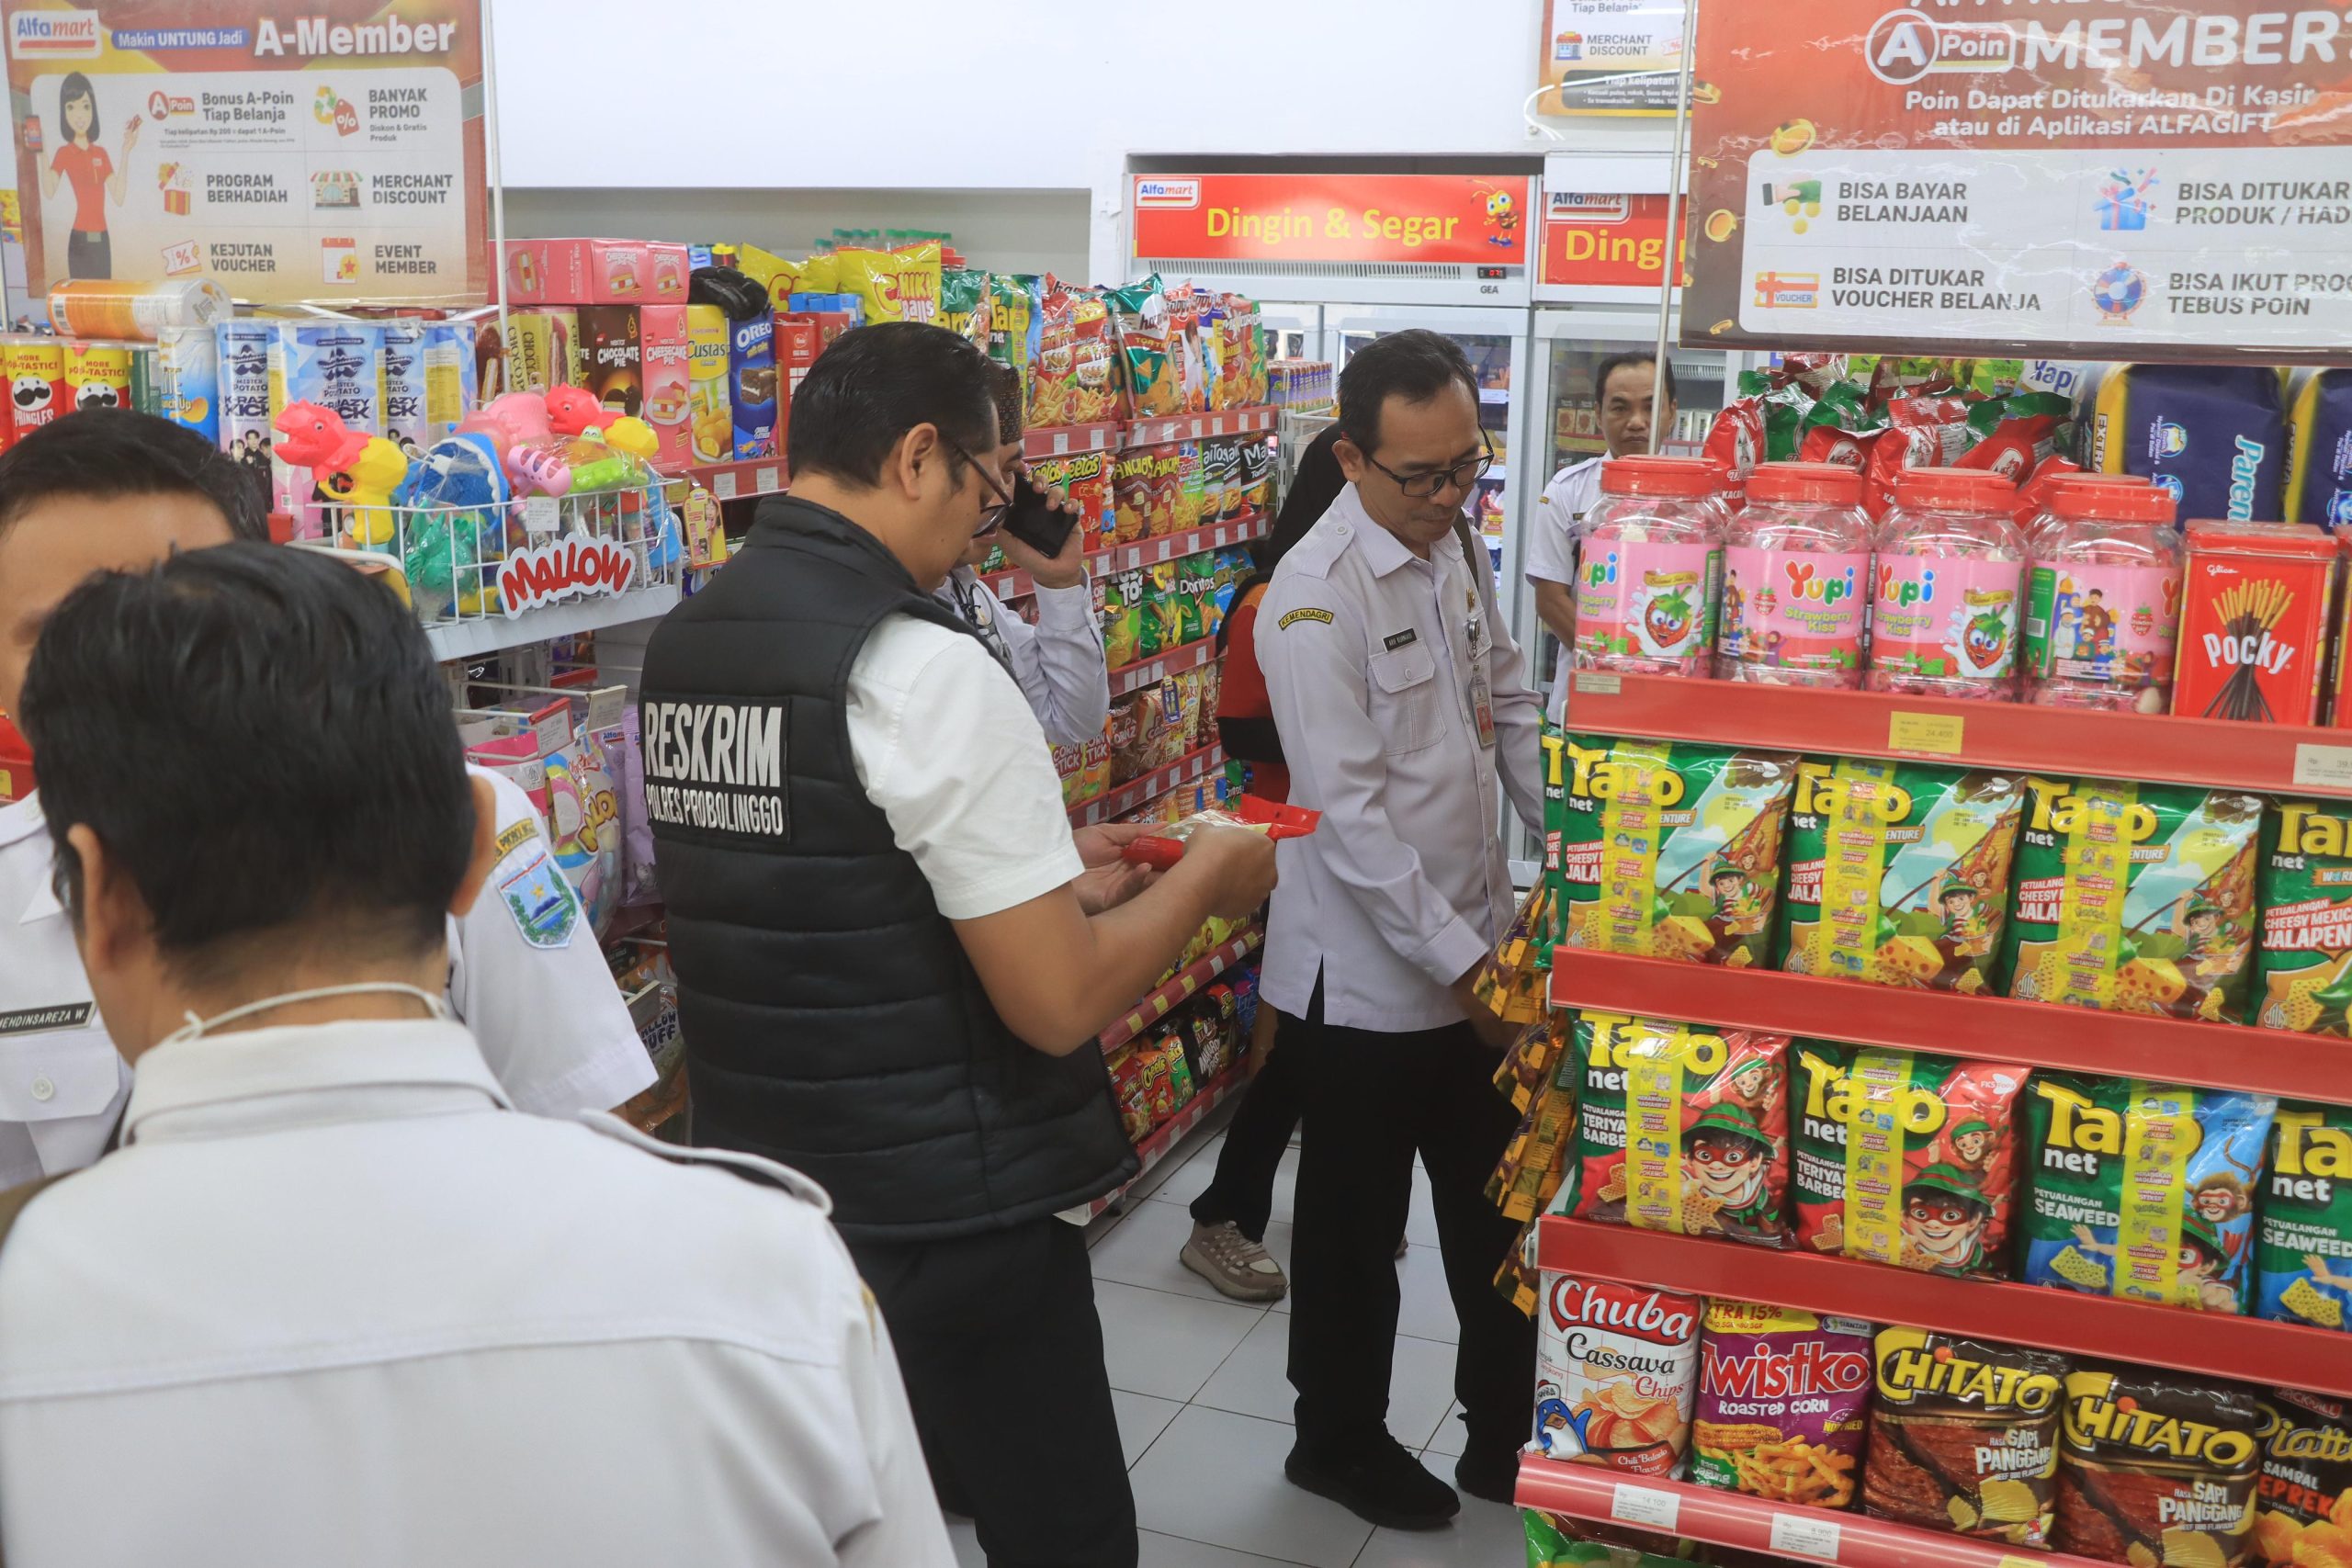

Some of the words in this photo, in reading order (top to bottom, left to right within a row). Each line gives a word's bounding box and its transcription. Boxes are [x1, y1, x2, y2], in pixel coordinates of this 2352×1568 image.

[1572, 3, 1595, 15] Tiap
[17, 16, 94, 38] Alfamart
[119, 33, 154, 48] Makin
[158, 31, 216, 47] UNTUNG
[219, 30, 243, 46] Jadi
[254, 16, 456, 57] A-Member
[1587, 35, 1653, 44] MERCHANT
[1877, 21, 1927, 67] A
[1940, 29, 2006, 58] Poin
[1589, 46, 1648, 56] DISCOUNT
[1628, 75, 1675, 86] kelipatan
[202, 93, 243, 105] Bonus
[246, 92, 294, 105] A-Poin
[368, 88, 427, 103] BANYAK
[1905, 90, 1959, 111] Poin
[1967, 90, 2044, 113] Dapat
[2051, 88, 2197, 110] Ditukarkan
[2205, 86, 2234, 107] Di
[2244, 82, 2314, 107] Kasir
[171, 100, 193, 110] Poin
[369, 105, 420, 118] PROMO
[203, 107, 230, 122] Tiap
[233, 107, 286, 122] Belanja
[1934, 118, 1990, 137] atau
[1996, 116, 2019, 136] di
[2027, 114, 2132, 139] Aplikasi
[2138, 111, 2277, 134] ALFAGIFT
[207, 175, 274, 188] PROGRAM
[372, 175, 453, 188] MERCHANT
[1141, 183, 1193, 197] Alfamart
[208, 189, 288, 204] BERHADIAH
[373, 190, 447, 204] DISCOUNT
[1553, 192, 1622, 208] Alfamart
[1838, 182, 1888, 199] BISA
[1895, 183, 1967, 200] BAYAR
[2178, 183, 2233, 200] BISA
[2242, 182, 2350, 200] DITUKAR
[1838, 205, 1968, 222] BELANJAAN
[2176, 207, 2277, 224] PRODUK
[2298, 206, 2352, 224] HAD
[1207, 208, 1313, 244] Dingin
[1325, 209, 1351, 239] &
[1363, 209, 1459, 246] Segar
[209, 243, 273, 258] KEJUTAN
[375, 245, 422, 258] EVENT
[1566, 228, 1665, 270] Ding
[211, 258, 276, 273] VOUCHER
[376, 261, 436, 274] MEMBER
[1833, 267, 1883, 285] BISA
[1889, 269, 1984, 287] DITUKAR
[2169, 273, 2223, 290] BISA
[2232, 274, 2288, 291] IKUT
[1480, 285, 1498, 294] GEA
[1775, 294, 1812, 302] VOUCHER
[1833, 290, 1934, 309] VOUCHER
[1940, 292, 2041, 311] BELANJA
[2168, 296, 2244, 315] TEBUS
[2251, 297, 2311, 315] POIN
[736, 322, 772, 349] OREO
[598, 346, 640, 364] CHOCOLATE
[614, 358, 627, 367] PIE
[646, 345, 688, 362] CHEESECAKE
[663, 355, 675, 366] PIE
[15, 409, 54, 427] PRINGLES
[2094, 413, 2108, 473] EXTRA
[2227, 434, 2264, 520] Paren
[502, 542, 632, 611] MALLOW
[2207, 565, 2239, 576] Glico
[1180, 577, 1215, 596] Doritos
[1785, 559, 1855, 605] Yupi
[1878, 561, 1935, 608] Yupi
[1280, 608, 1331, 627] KEMENDAGRI
[1785, 606, 1852, 624] Strawberry
[1807, 620, 1837, 633] Kiss
[1886, 622, 1911, 637] Kiss
[2202, 632, 2295, 674] POCKY
[645, 702, 783, 787] RESKRIM
[1567, 744, 1685, 807] Tao
[1794, 762, 1913, 823] Tao
[646, 783, 684, 824] POLRES
[683, 788, 784, 836] PROBOLINGGO
[1569, 796, 1593, 813] net
[2027, 776, 2159, 842] Tao
[1566, 840, 1602, 853] PETUALANG
[2025, 829, 2054, 848] net
[1566, 852, 1598, 864] CHEESY
[1791, 860, 1825, 873] PETUALANG
[2271, 853, 2304, 871] net
[1790, 871, 1820, 885] CHEESY
[2021, 878, 2064, 890] PETUALANG
[2019, 889, 2060, 903] CHEESY
[2265, 899, 2330, 917] PETUALANGAN
[2265, 915, 2309, 930] CHEESY
[75, 1009, 86, 1021] W.
[1580, 1010, 1727, 1075] Tao
[1588, 1069, 1627, 1091] net
[1801, 1051, 1945, 1134] Tao
[1582, 1102, 1626, 1118] PETUALANGA
[1582, 1112, 1626, 1133] TERIYA
[1804, 1118, 1847, 1143] net
[1582, 1127, 1626, 1148] BARBE
[1796, 1150, 1846, 1170] PETUALANGAN
[2043, 1148, 2098, 1175] net
[2034, 1187, 2102, 1208] PETUALANGAN
[2272, 1177, 2332, 1201] net
[2035, 1199, 2120, 1226] SEAWEED
[2263, 1216, 2337, 1236] PETUALANGAN
[1556, 1279, 1692, 1340] Chuba
[1749, 1305, 1782, 1320] 15%
[1566, 1332, 1675, 1374] Cassava
[1701, 1340, 1869, 1398] Twistko
[1634, 1375, 1684, 1404] Chips
[1791, 1399, 1829, 1414] CORN
[2007, 1427, 2040, 1449] SAPI
[1618, 1454, 1639, 1465] Chili
[1975, 1446, 2052, 1474] PANGGANG
[2263, 1461, 2319, 1490] SAMBAL
[2192, 1481, 2228, 1504] SAPI
[2258, 1475, 2336, 1516] EPREK
[2159, 1496, 2243, 1523] PANGGANG
